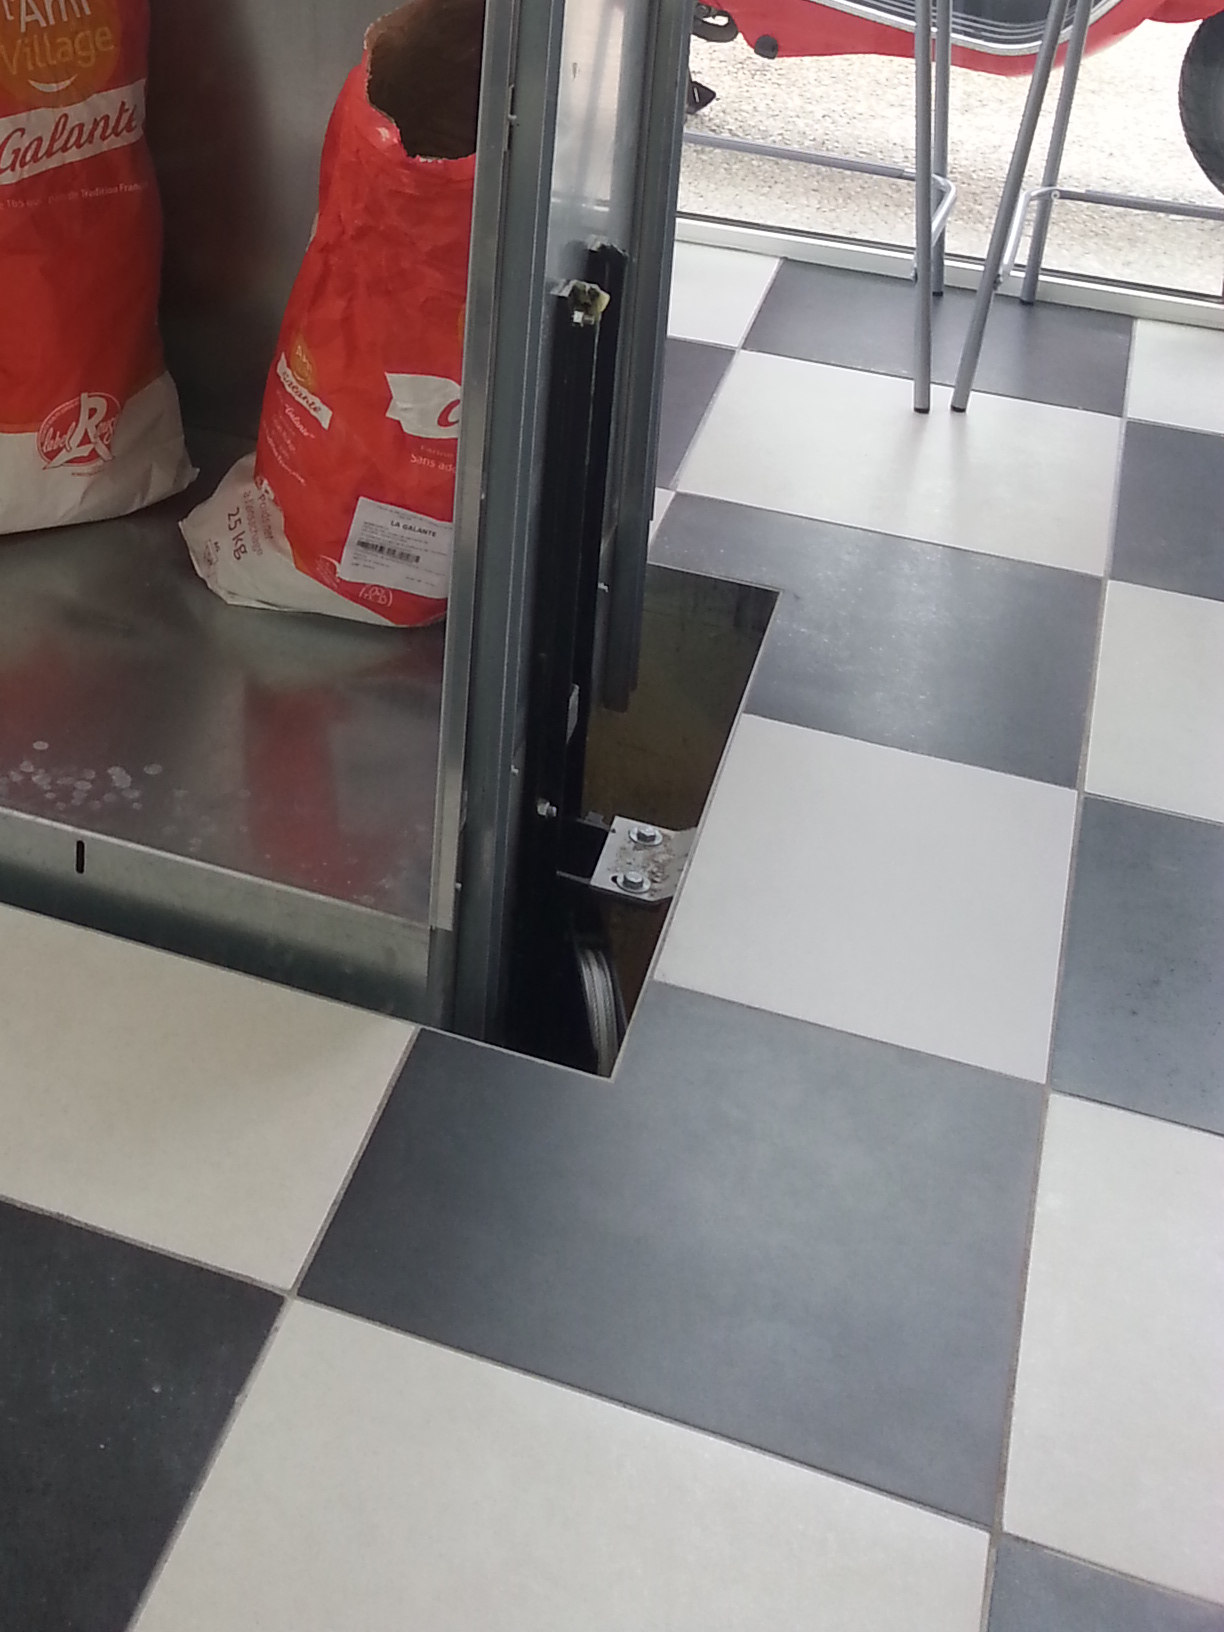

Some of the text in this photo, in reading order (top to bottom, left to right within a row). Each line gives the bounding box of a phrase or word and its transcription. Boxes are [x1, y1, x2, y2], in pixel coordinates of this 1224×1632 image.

[410, 453, 436, 468] Sans
[227, 506, 249, 561] 25 kg
[390, 519, 437, 538] LA GALANTE
